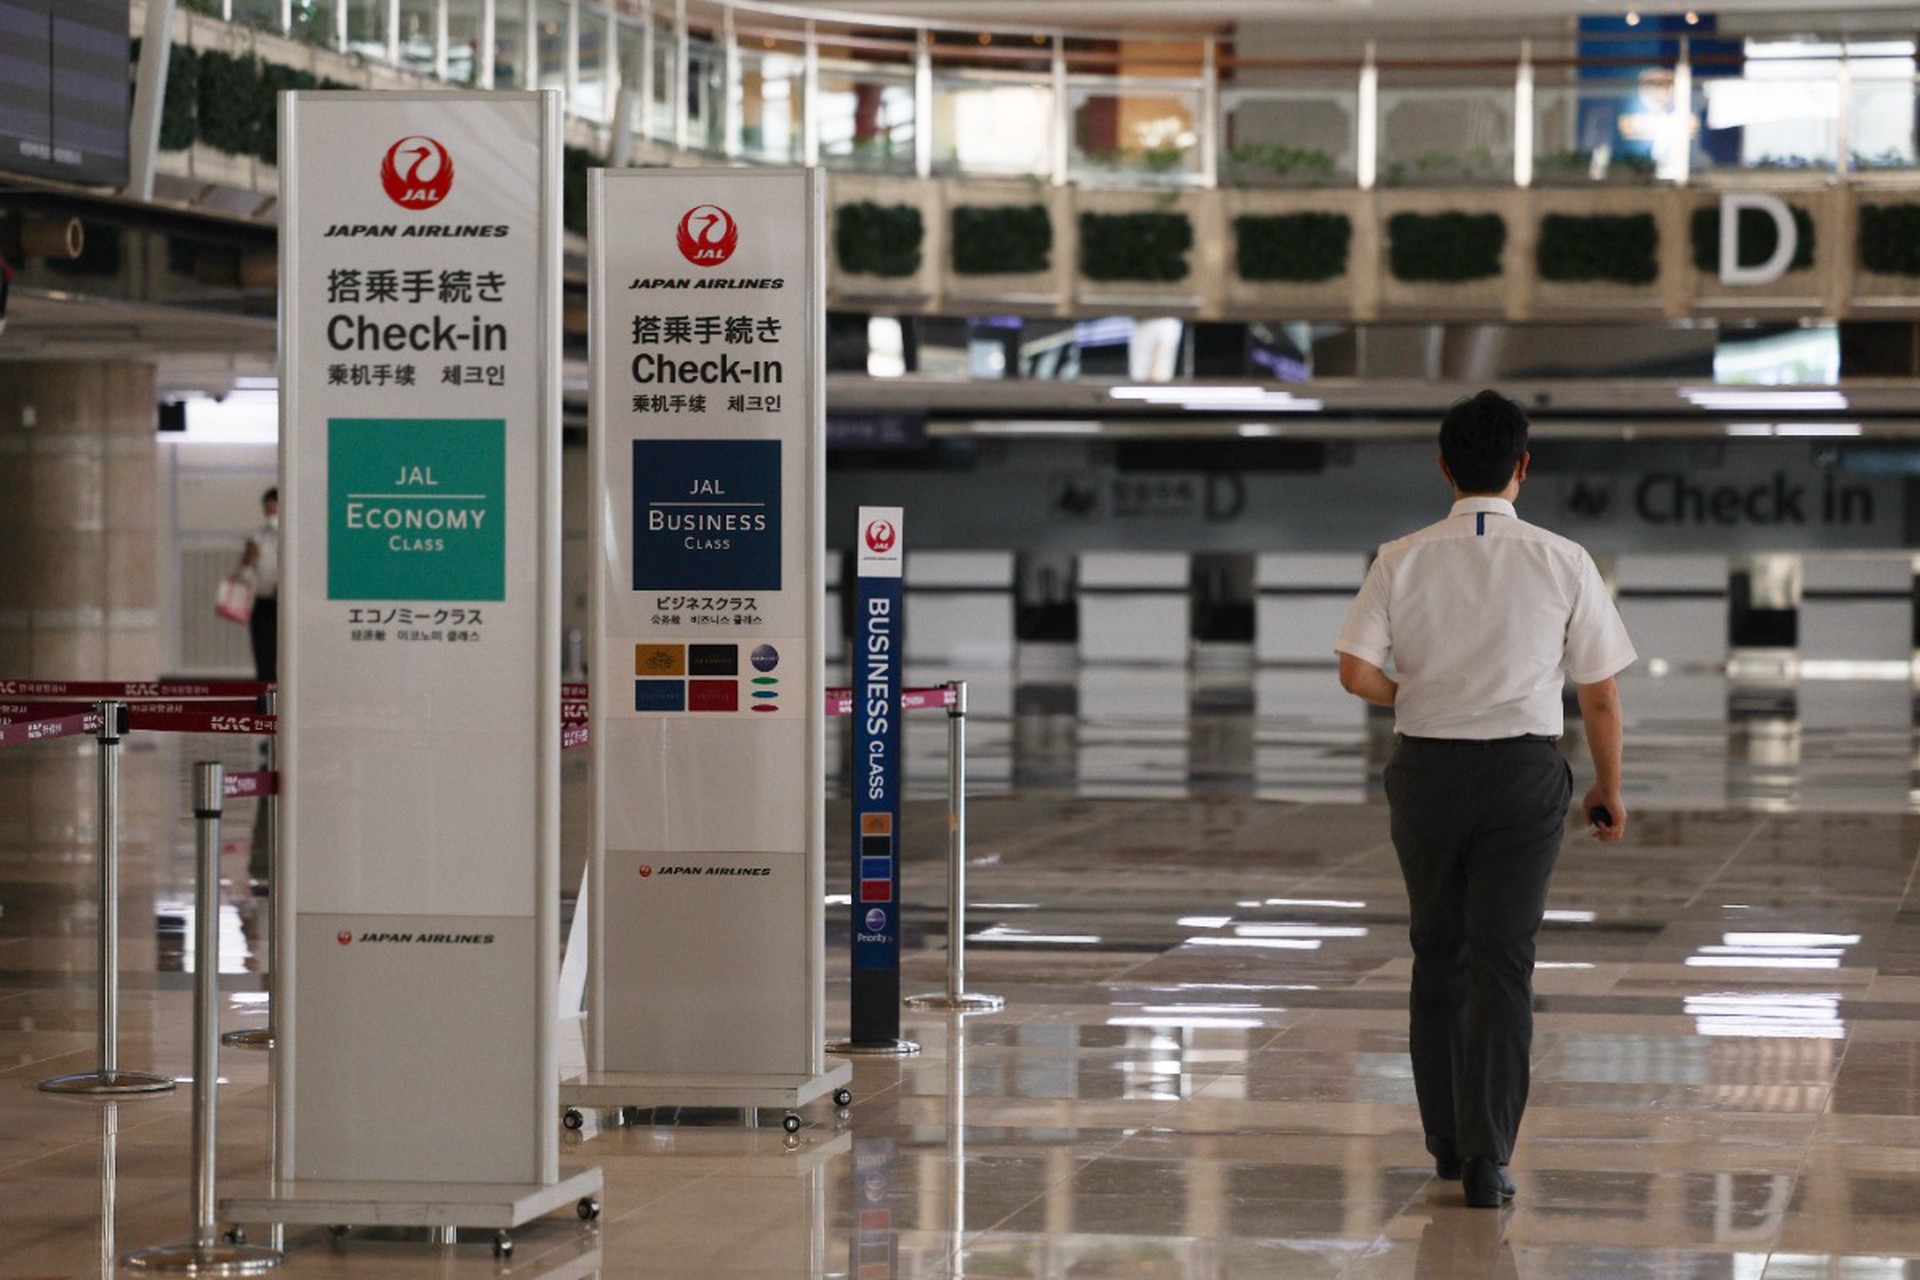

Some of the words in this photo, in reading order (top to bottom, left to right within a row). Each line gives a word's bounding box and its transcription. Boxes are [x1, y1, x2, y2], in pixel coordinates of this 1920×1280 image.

[400, 188, 440, 201] JAL
[324, 225, 398, 238] JAPAN
[402, 225, 510, 238] AIRLINES
[1720, 194, 1798, 286] D
[693, 248, 726, 259] JAL
[327, 269, 507, 304] 搭乗手続き
[628, 278, 691, 290] JAPAN
[693, 278, 785, 290] AIRLINES
[327, 314, 507, 352] Check-in
[631, 315, 782, 345] 搭乗手続き
[327, 364, 416, 387] 乘机手续
[441, 364, 505, 387] 체크인
[631, 353, 783, 384] Check-in
[632, 394, 706, 414] 乘机手续
[727, 394, 781, 413] 체크인
[395, 465, 438, 486] JAL
[689, 479, 725, 495] JAL
[1634, 471, 1804, 524] Check
[1820, 471, 1874, 524] in
[656, 596, 757, 611] ビジネスクラス
[348, 608, 483, 625] エコノミークラス
[866, 598, 890, 736] BUSINESS
[210, 716, 250, 731] KAC
[868, 740, 884, 800] CLASS
[658, 866, 703, 875] JAPAN
[705, 867, 771, 876] AIRLINES
[359, 933, 412, 943] JAPAN
[415, 934, 494, 944] AIRLINES
[857, 932, 887, 944] Priority
